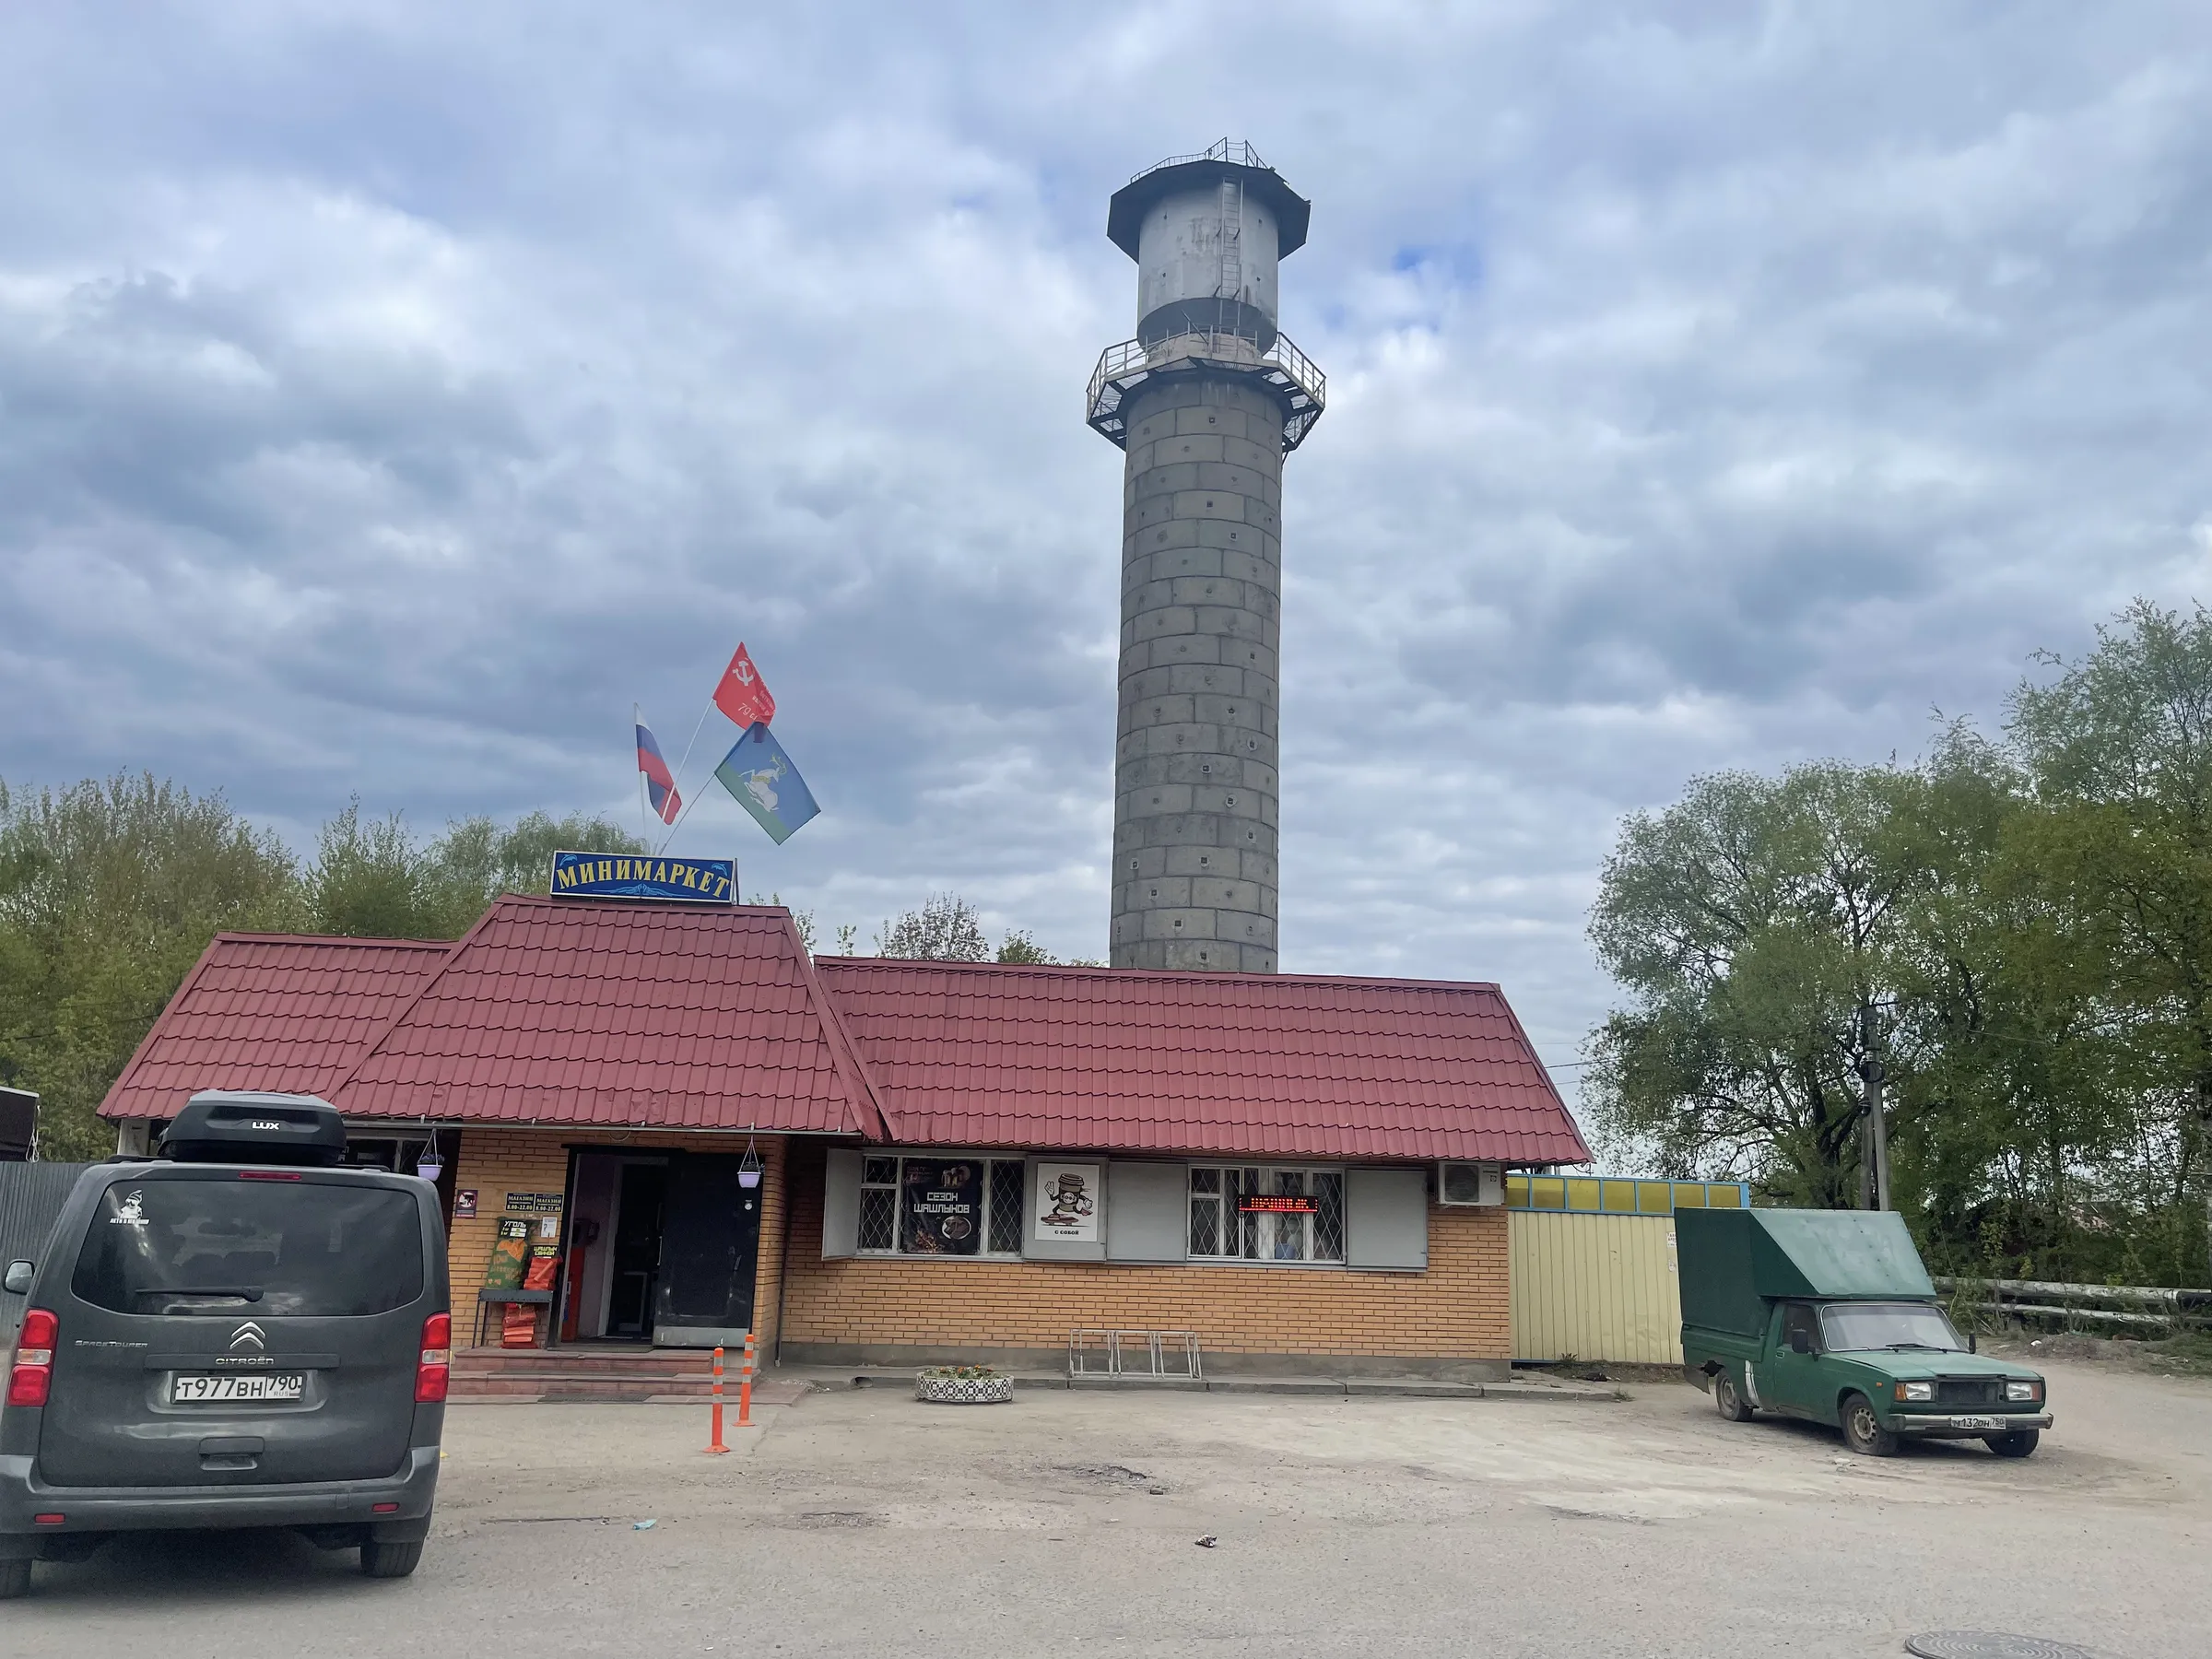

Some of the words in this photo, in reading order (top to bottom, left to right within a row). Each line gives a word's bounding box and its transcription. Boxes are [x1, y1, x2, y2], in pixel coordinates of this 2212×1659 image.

[557, 859, 731, 898] МИНИМАРКЕТ
[252, 1121, 280, 1130] LUX
[926, 1192, 959, 1202] СЕЗОН
[913, 1203, 971, 1214] ШАШЛЫКОВ
[503, 1220, 526, 1229] УГОЛЬ
[215, 1356, 275, 1365] CITROËN
[268, 1376, 299, 1391] 790
